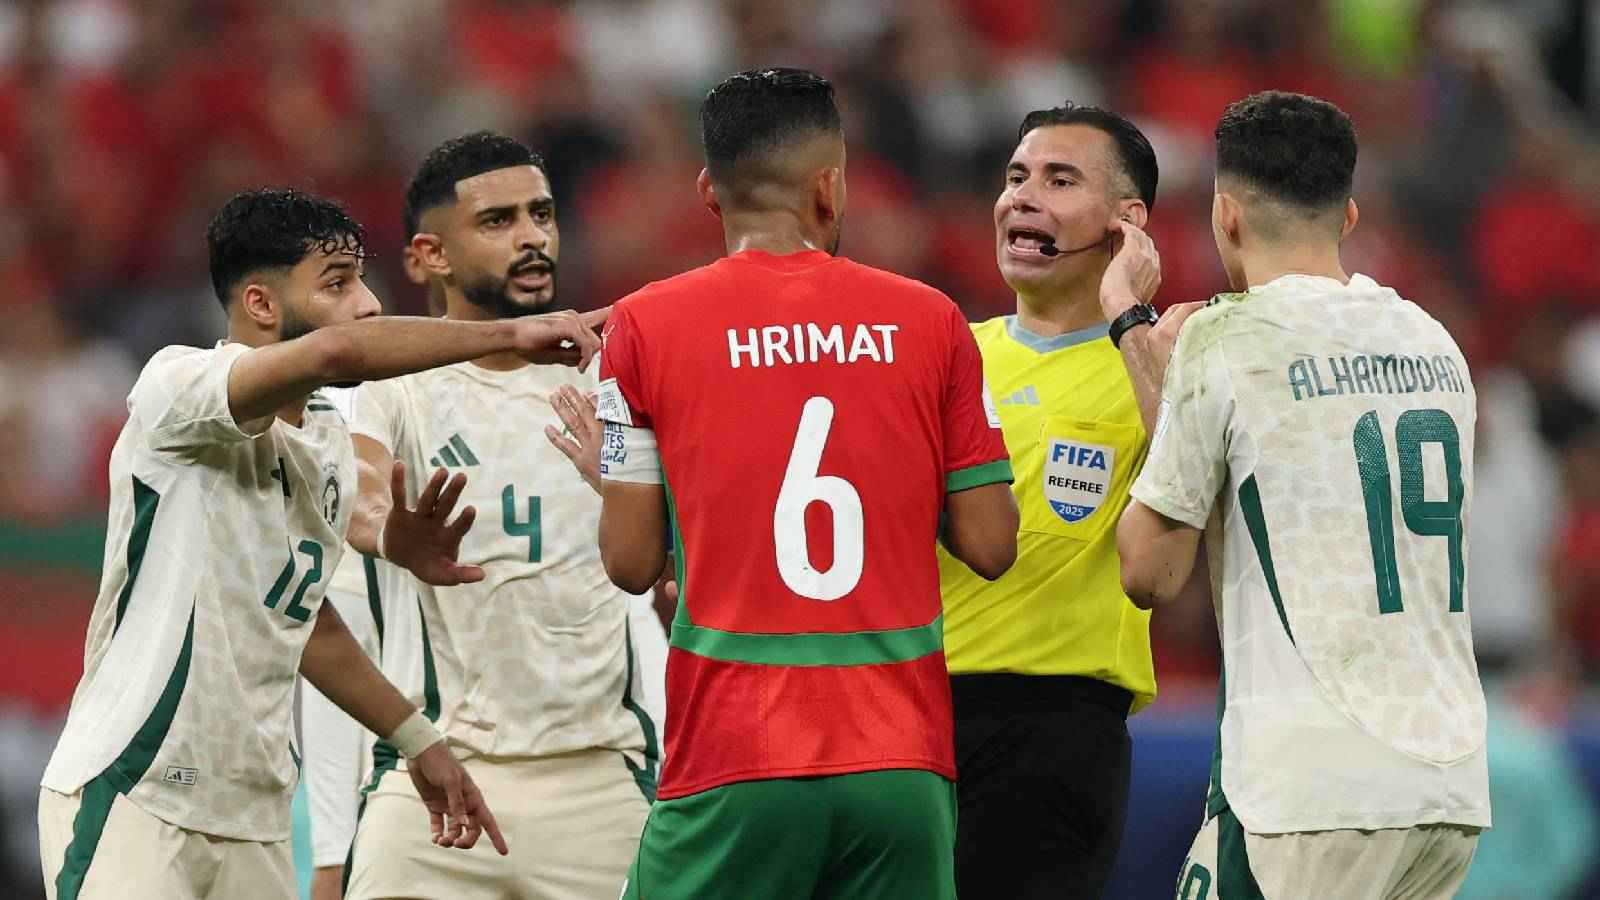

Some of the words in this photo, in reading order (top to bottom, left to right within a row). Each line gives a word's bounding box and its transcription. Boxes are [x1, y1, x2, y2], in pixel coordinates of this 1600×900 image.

[727, 322, 899, 368] HRIMAT
[1288, 354, 1465, 400] ALHAMDDAN
[1052, 443, 1106, 470] FIFA
[774, 396, 864, 601] 6
[1048, 475, 1103, 494] REFEREE
[501, 484, 542, 562] 4
[1059, 504, 1084, 517] 2025
[1353, 409, 1464, 614] 19
[263, 540, 323, 622] 12
